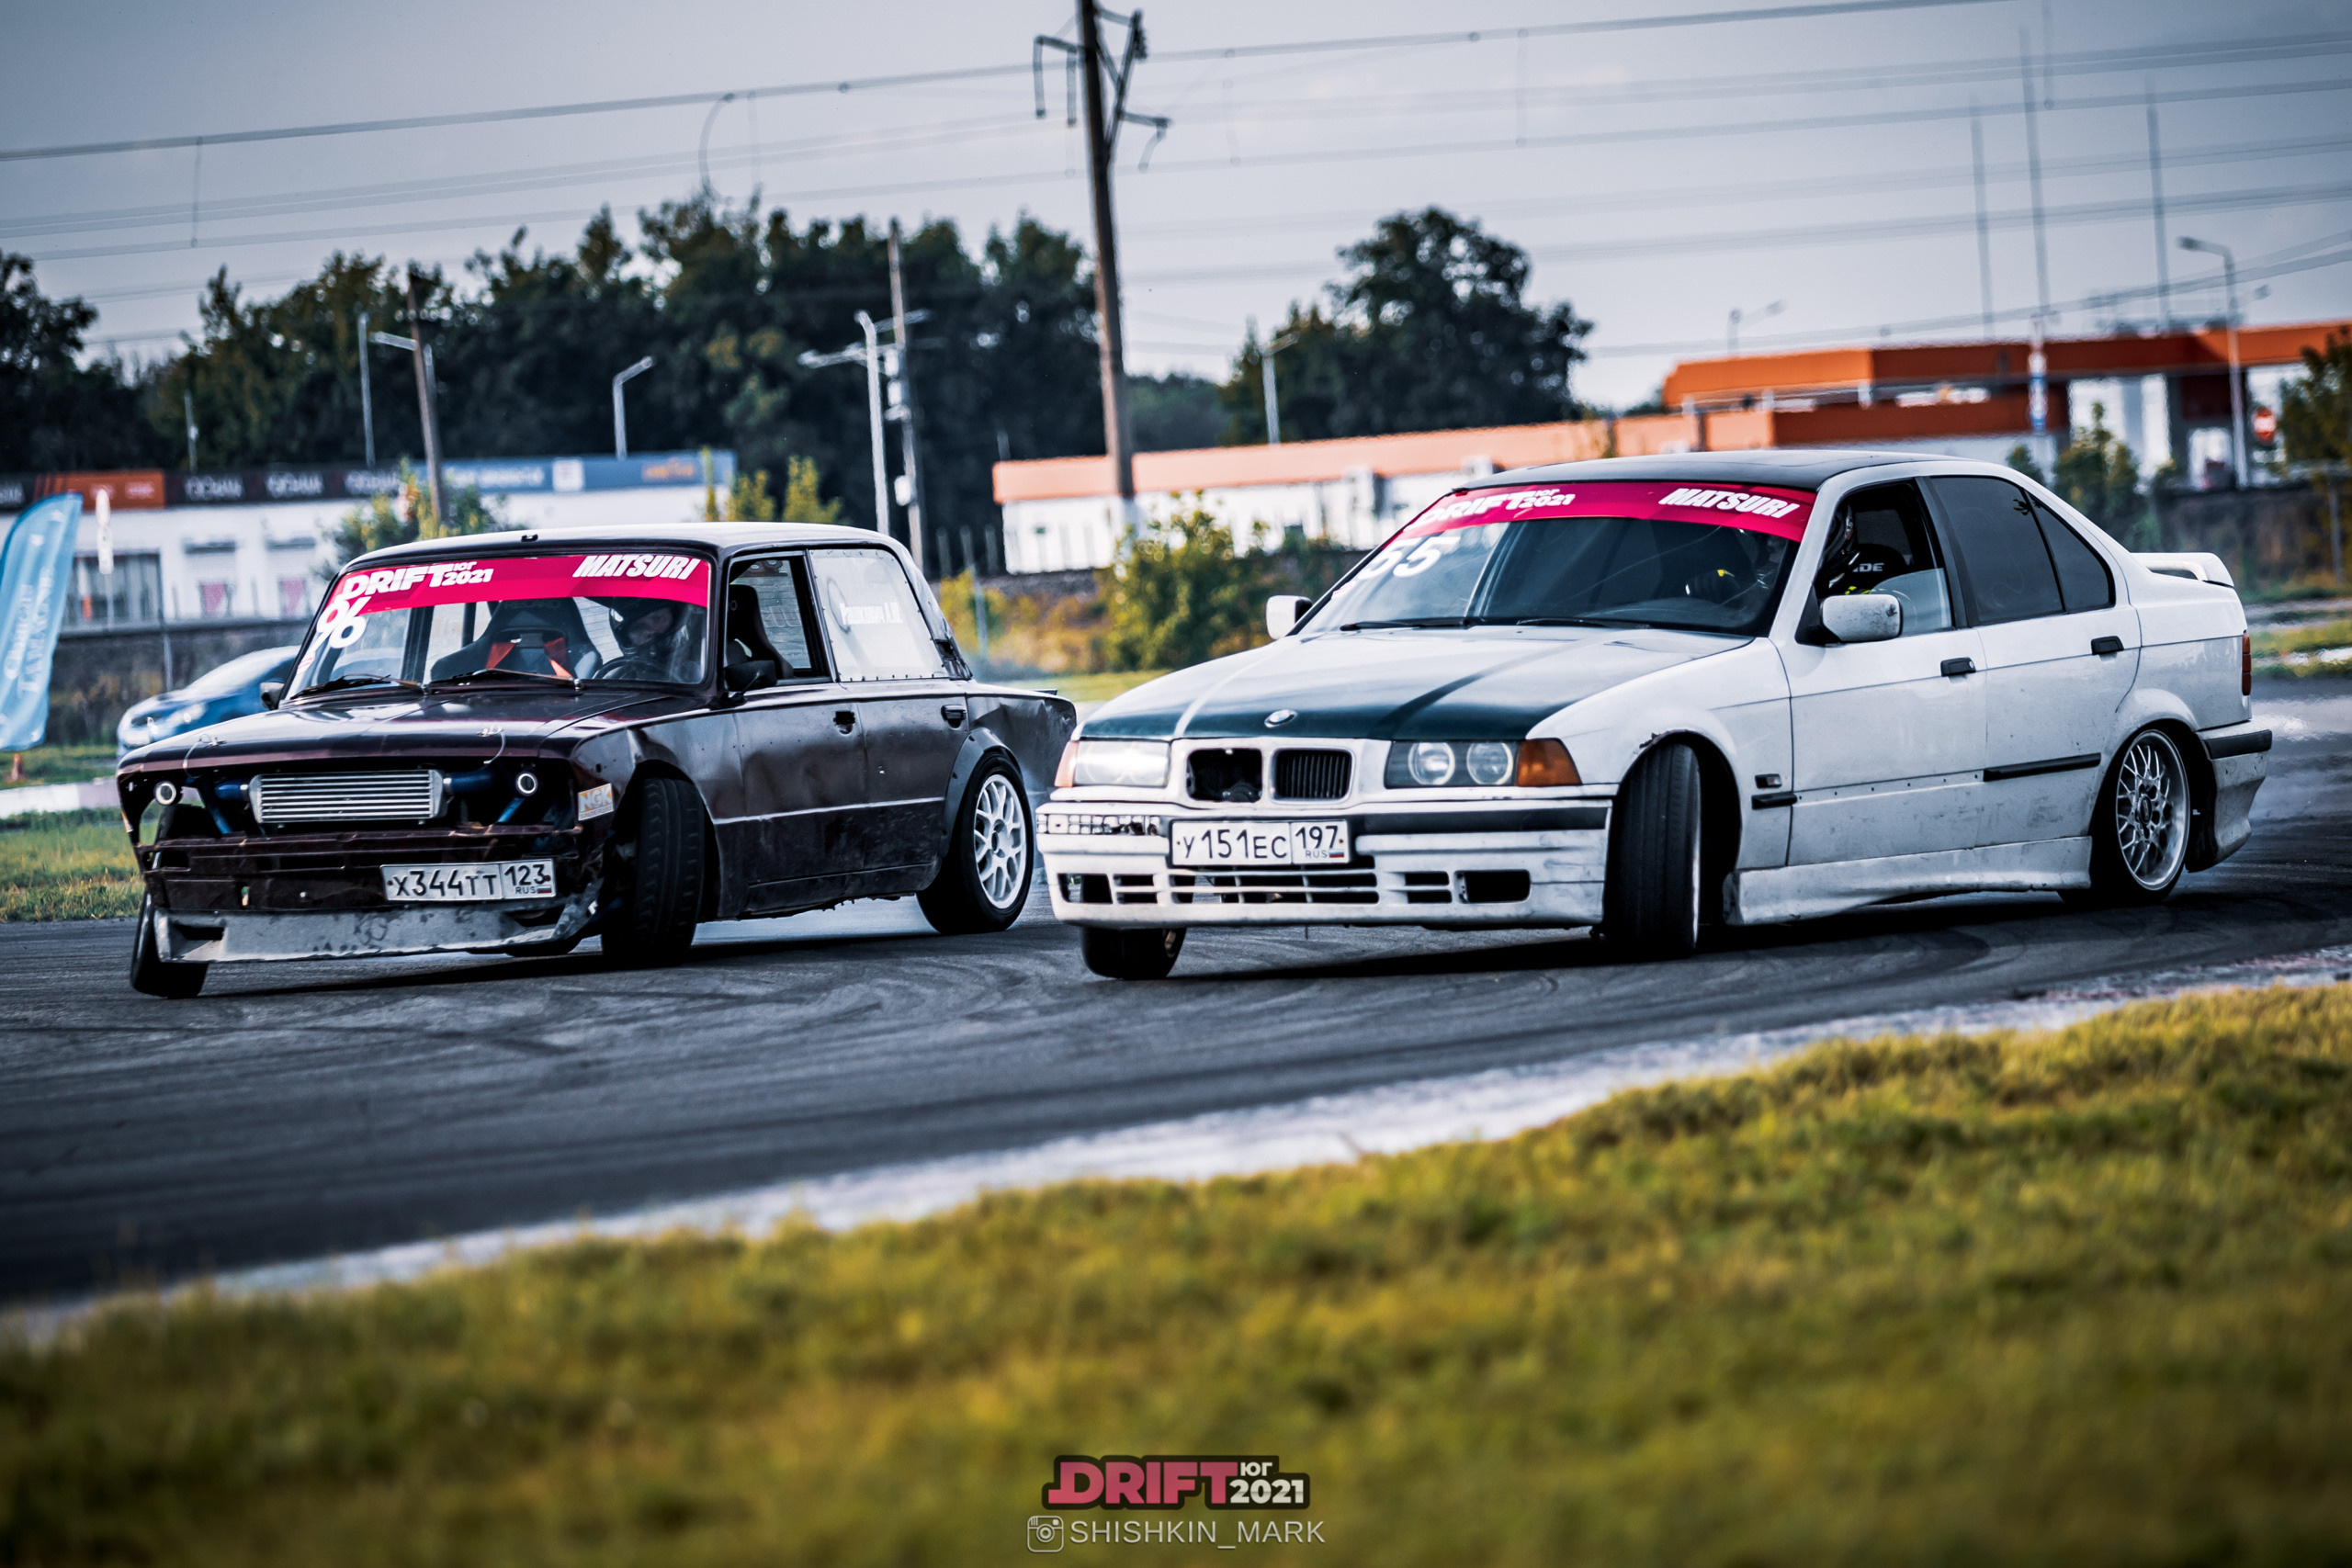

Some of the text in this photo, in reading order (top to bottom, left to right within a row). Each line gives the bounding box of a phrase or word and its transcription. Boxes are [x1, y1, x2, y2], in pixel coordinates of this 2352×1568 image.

[1519, 494, 1576, 509] 2021
[1658, 488, 1800, 518] MATSURI
[442, 569, 494, 586] 2021
[572, 555, 701, 581] MATSURI
[336, 563, 455, 600] DRIFT
[580, 784, 613, 813] NGK
[1295, 825, 1339, 849] 197
[1306, 850, 1328, 859] RUS
[504, 863, 546, 886] 123
[515, 886, 537, 895] RUS
